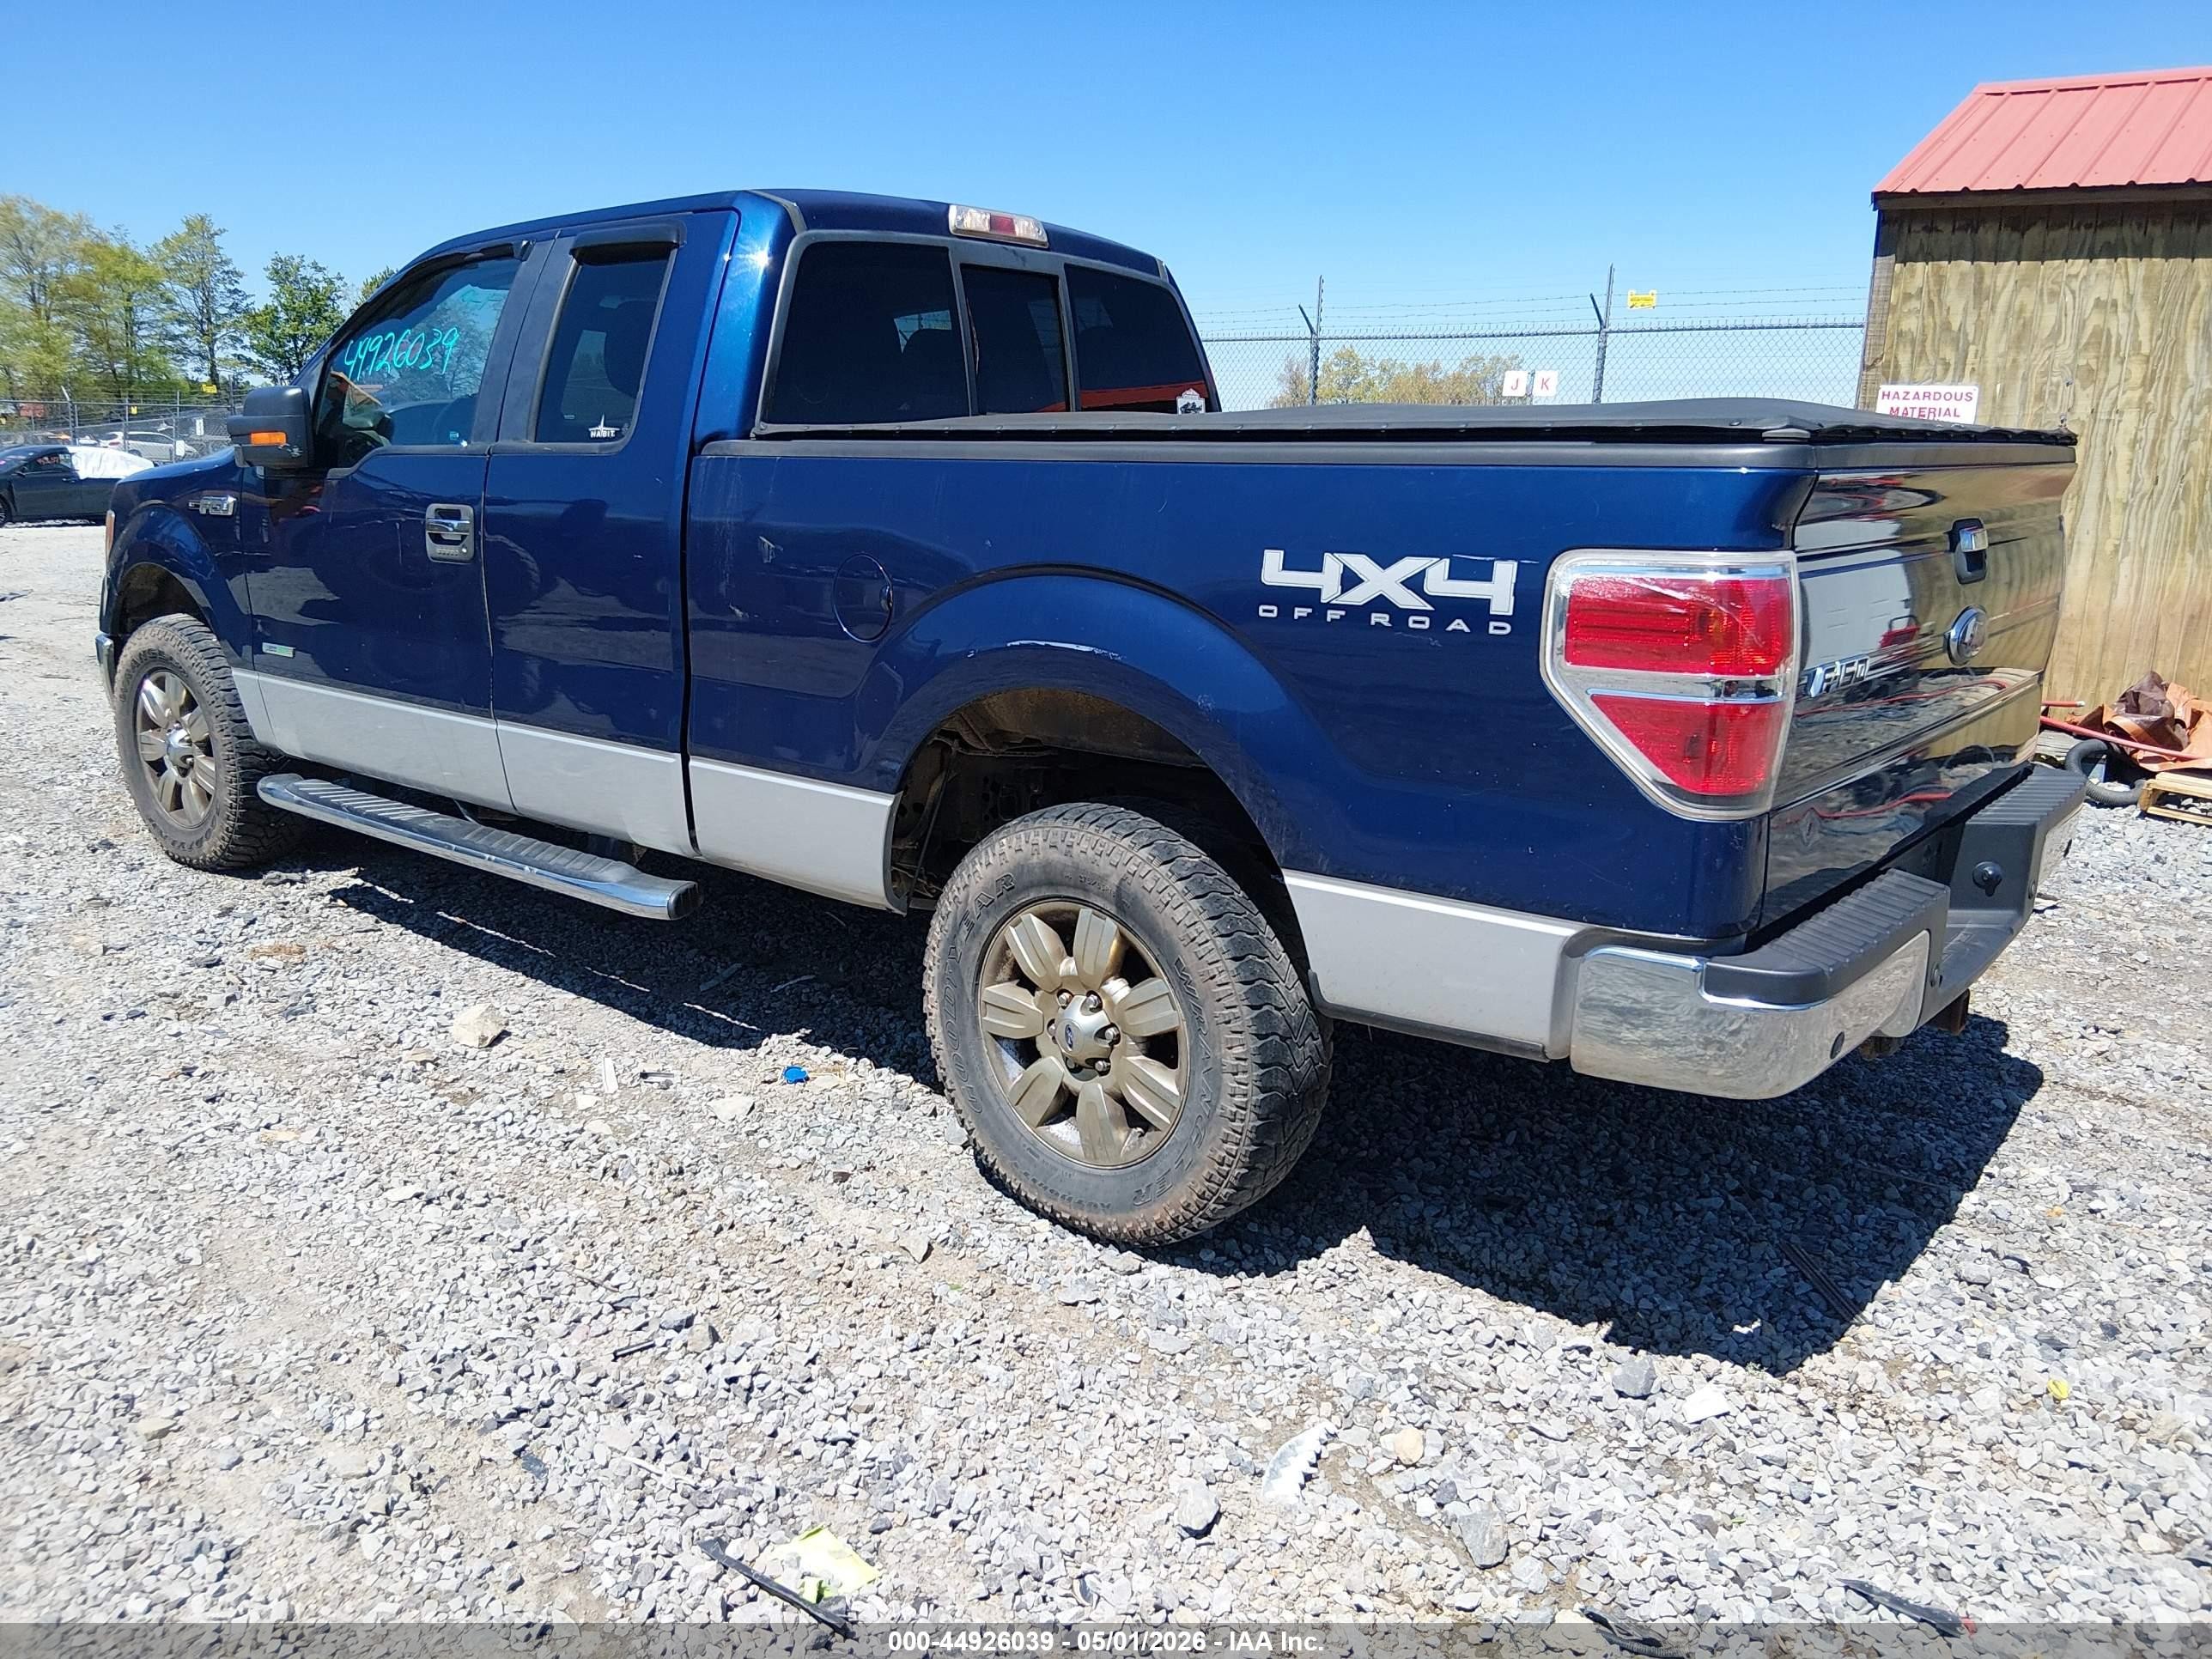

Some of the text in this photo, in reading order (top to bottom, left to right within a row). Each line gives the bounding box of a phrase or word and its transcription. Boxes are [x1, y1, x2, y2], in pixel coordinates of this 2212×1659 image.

[343, 326, 459, 379] 44926039
[1510, 378, 1519, 391] J
[1541, 377, 1551, 391] K
[1881, 391, 1973, 402] HAZARDOUS
[1890, 406, 1961, 420] MATERIAL
[1261, 549, 1518, 616] 4X4
[945, 872, 1016, 1114] GOODYEAR
[1133, 956, 1213, 1206] WRANGLER
